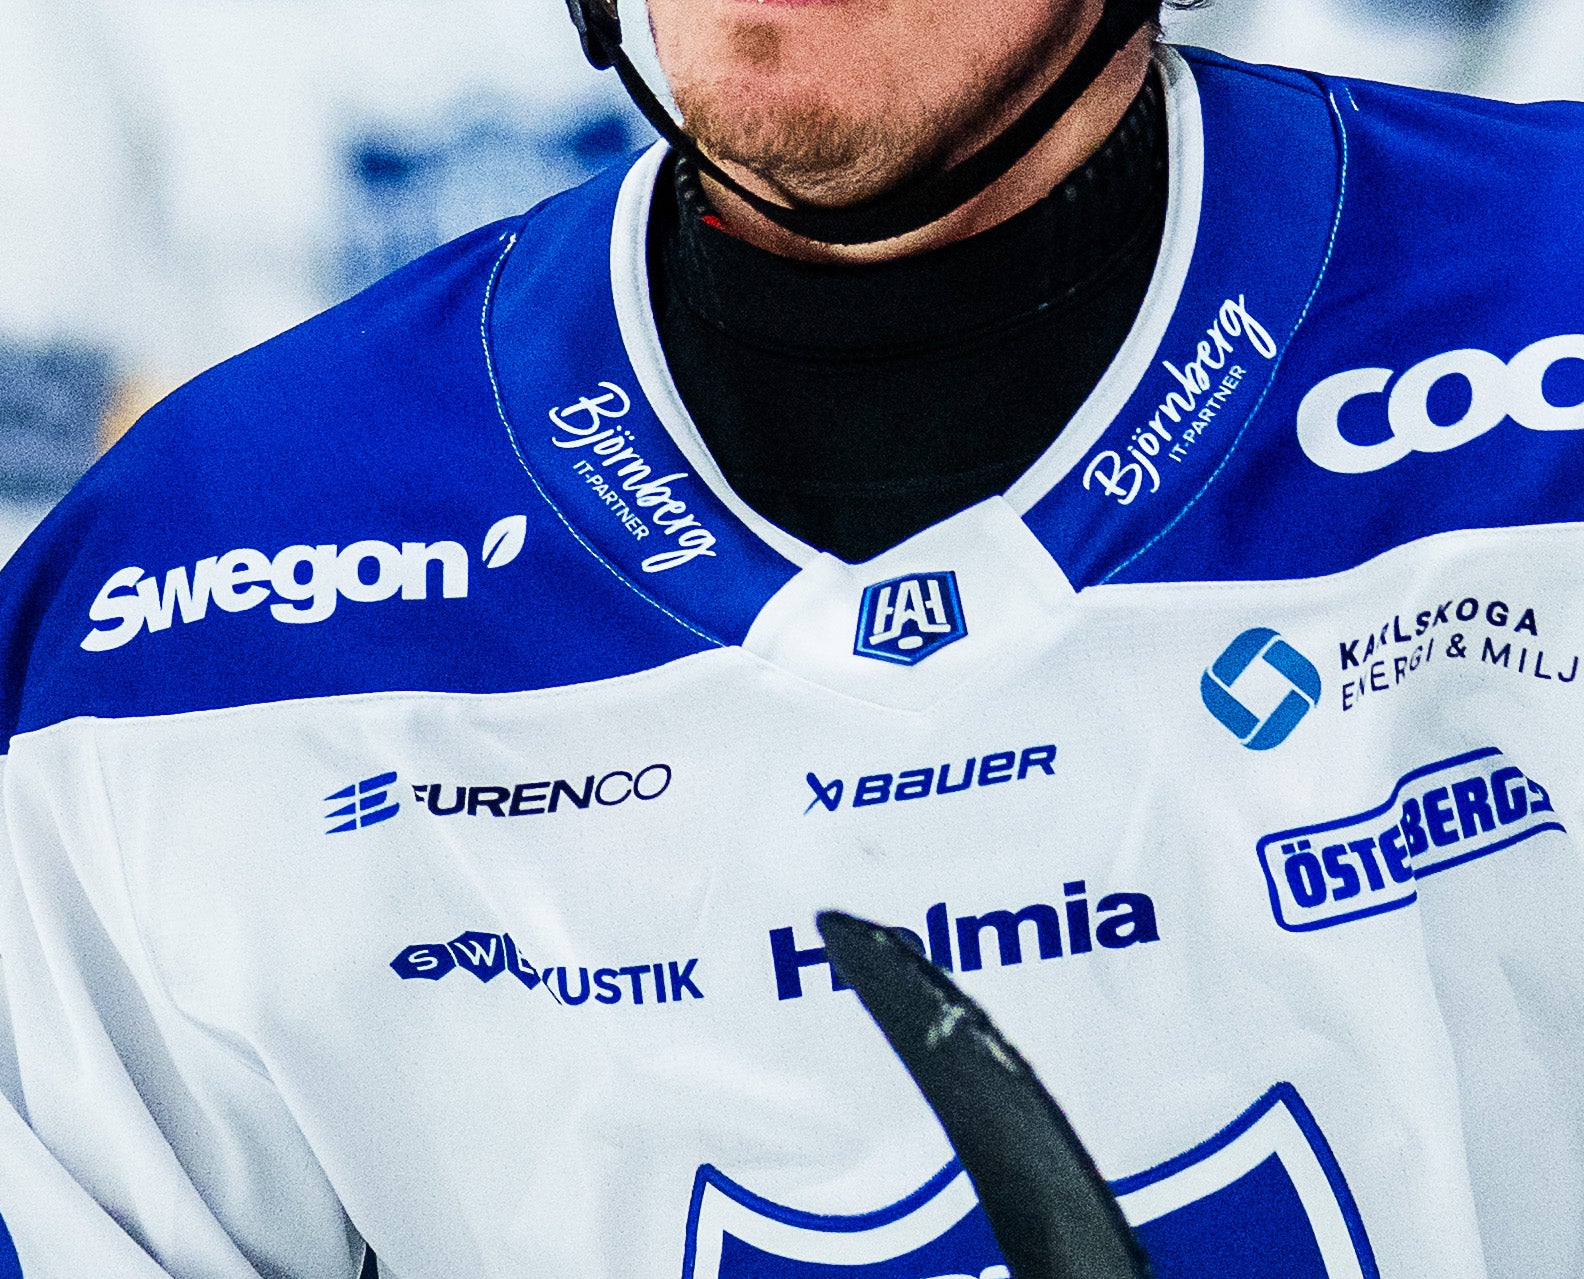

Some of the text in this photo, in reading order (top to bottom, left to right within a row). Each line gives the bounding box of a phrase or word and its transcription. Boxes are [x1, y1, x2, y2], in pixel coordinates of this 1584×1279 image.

[1083, 292, 1277, 506] Björnberg
[1168, 364, 1246, 463] IT-PARTNER
[549, 381, 716, 573] Björnberg
[572, 459, 651, 542] IT-PARTNER
[80, 538, 469, 652] Swegon
[1339, 597, 1538, 670] KARLSKOGA
[1342, 637, 1434, 711] ENERGI
[1446, 632, 1467, 659] &
[852, 744, 1057, 808] BAUER
[1281, 766, 1555, 909] ÖSTEBERGS
